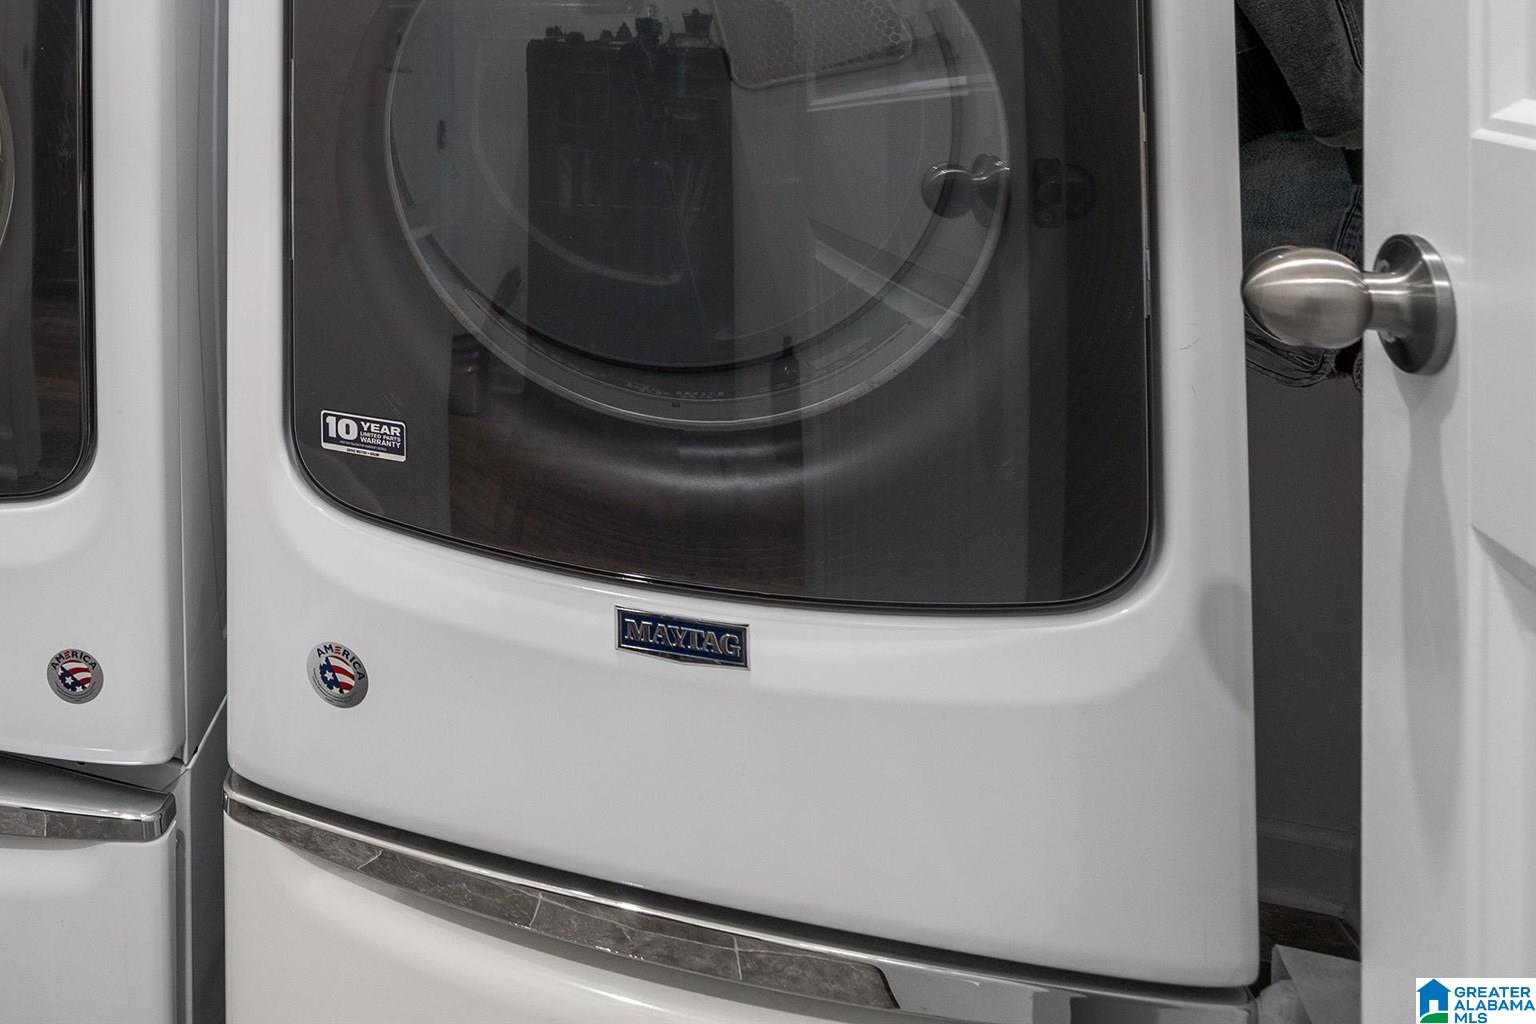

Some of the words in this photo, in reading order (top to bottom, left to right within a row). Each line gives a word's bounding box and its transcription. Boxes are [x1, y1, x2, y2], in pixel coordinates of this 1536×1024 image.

[326, 416, 358, 441] 10
[360, 421, 401, 436] YEAR
[360, 432, 381, 440] LIMITED
[382, 434, 401, 442] PARTS
[360, 436, 401, 449] WARRANTY
[624, 618, 741, 657] MAYTAG
[51, 650, 97, 670] AMERICA
[316, 644, 366, 681] AMERICA
